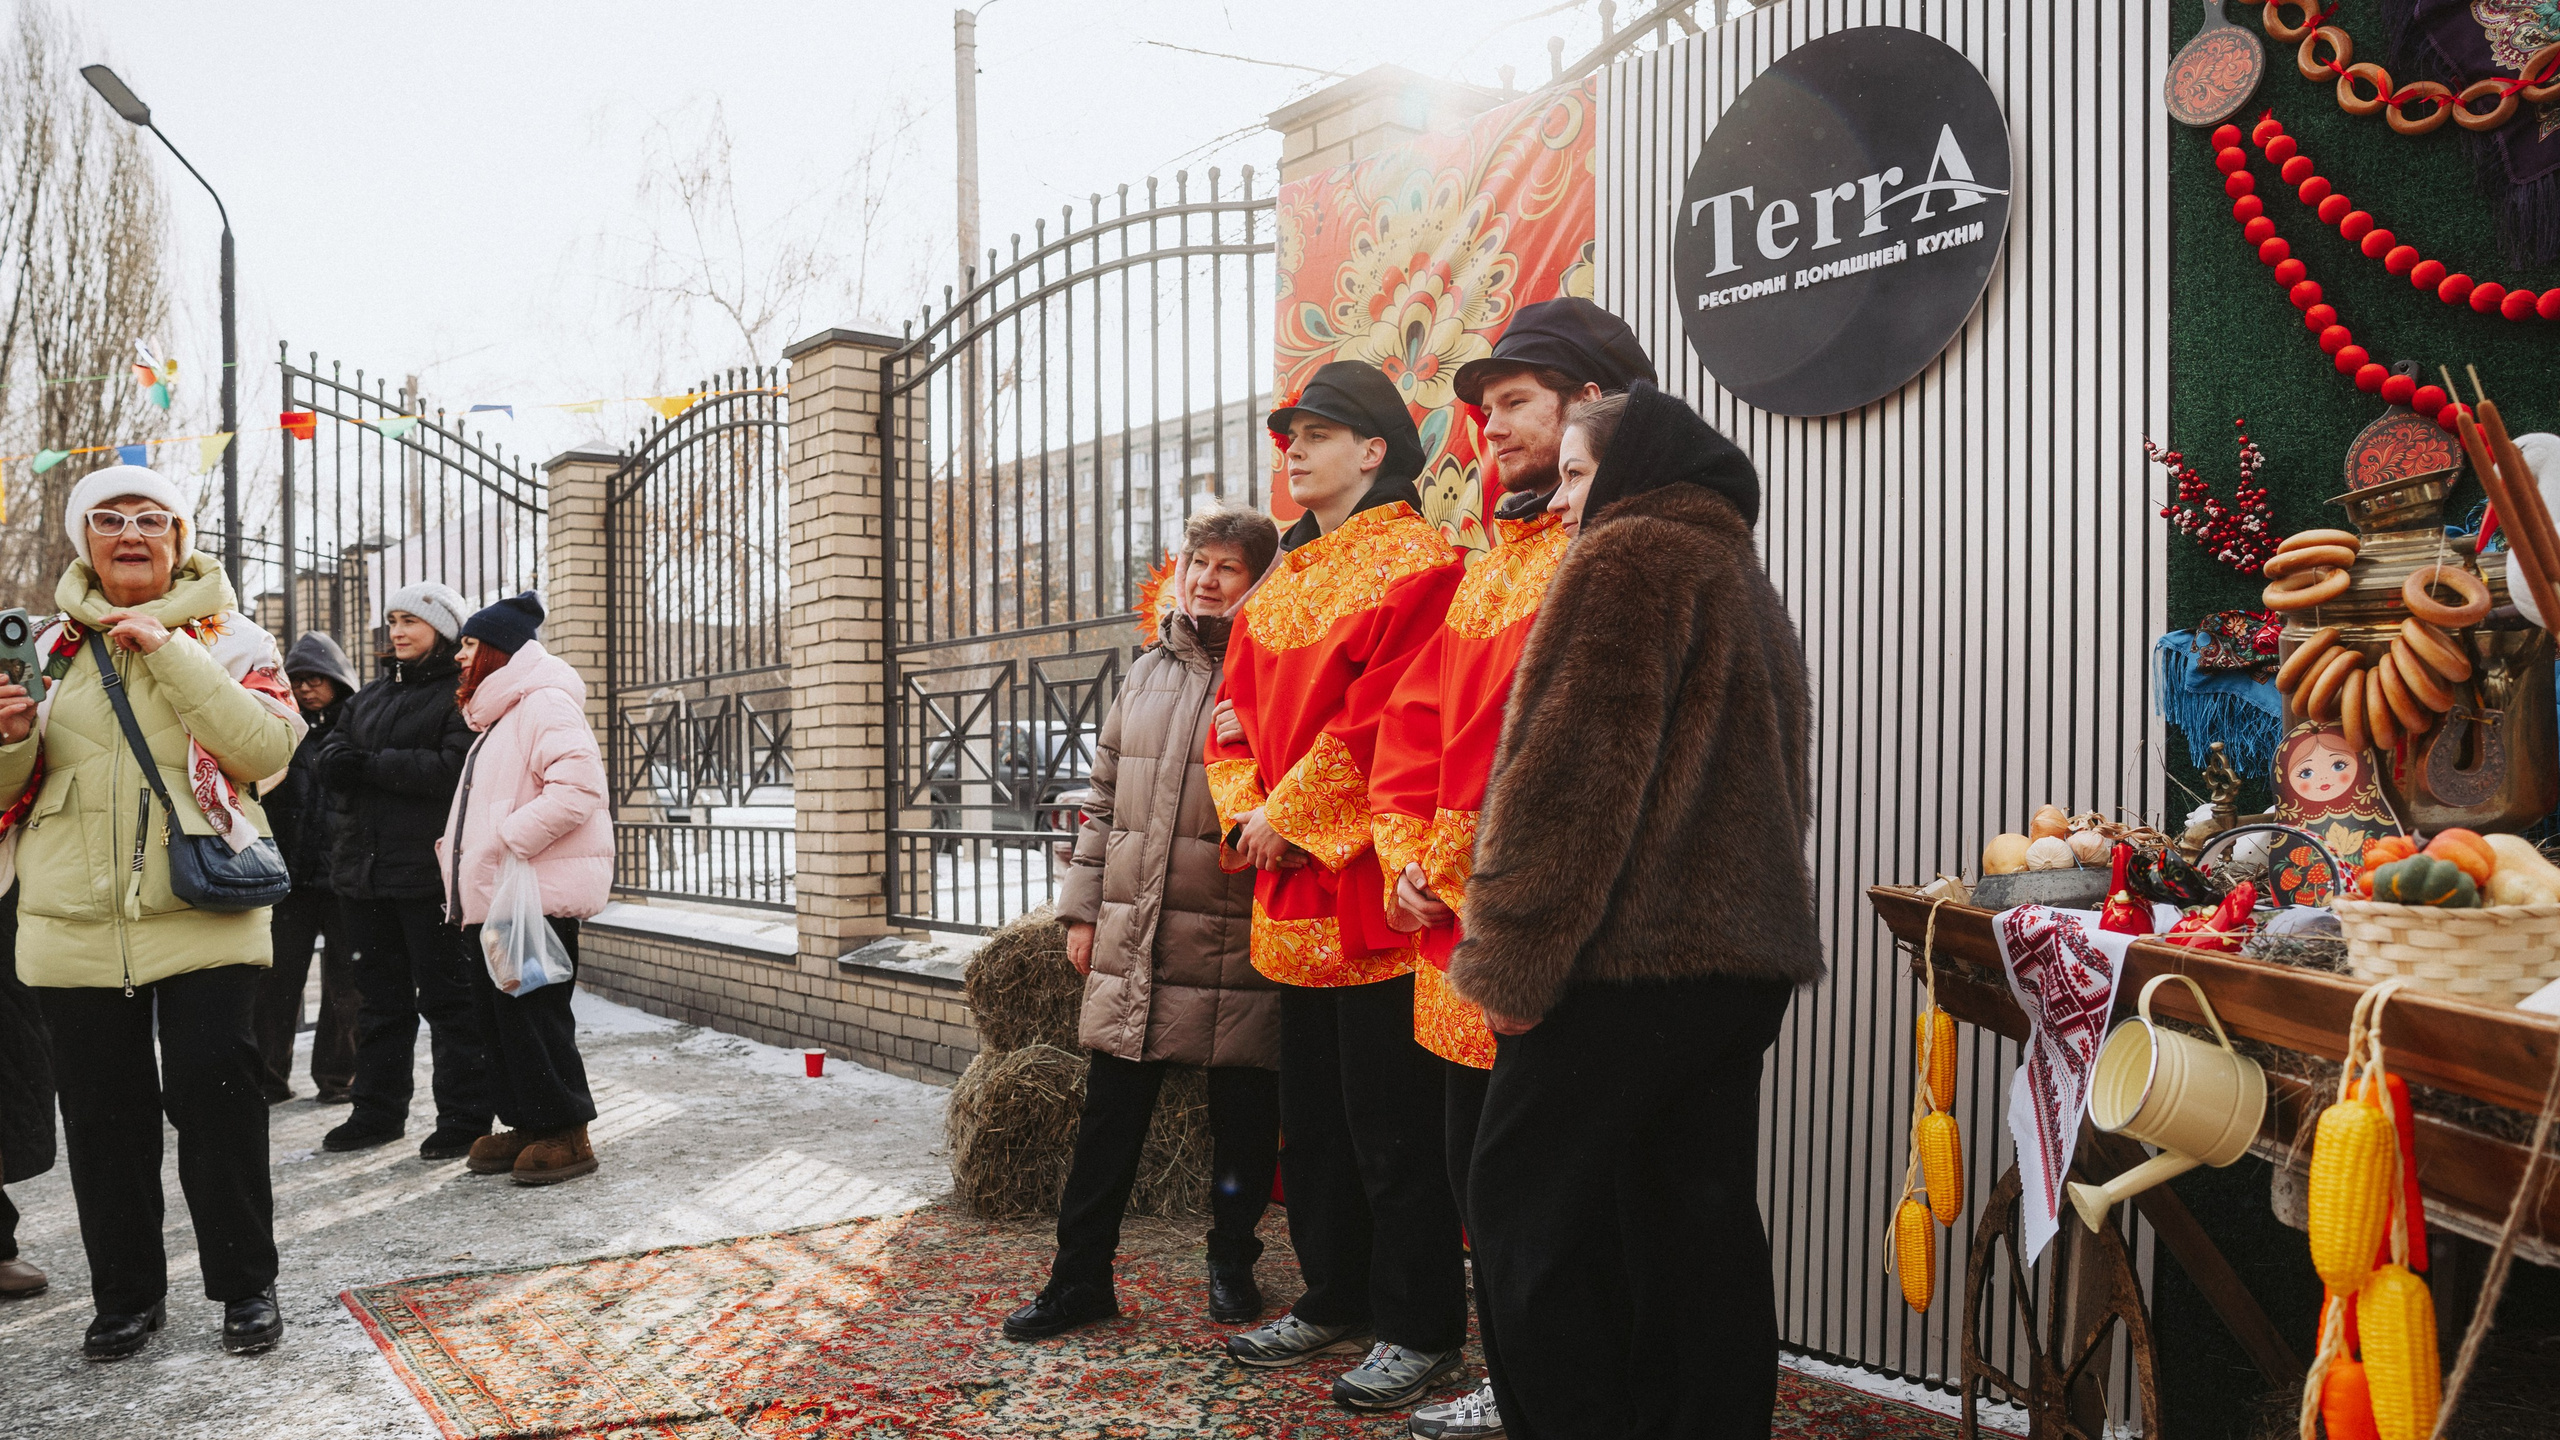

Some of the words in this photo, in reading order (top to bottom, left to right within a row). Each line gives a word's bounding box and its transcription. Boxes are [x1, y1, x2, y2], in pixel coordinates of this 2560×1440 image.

[1691, 124, 2009, 278] TerrA
[1698, 274, 1787, 310] РЕСТОРАН
[1794, 241, 1907, 290] ДОМАШНЕЙ
[1917, 221, 1984, 256] КУХНИ
